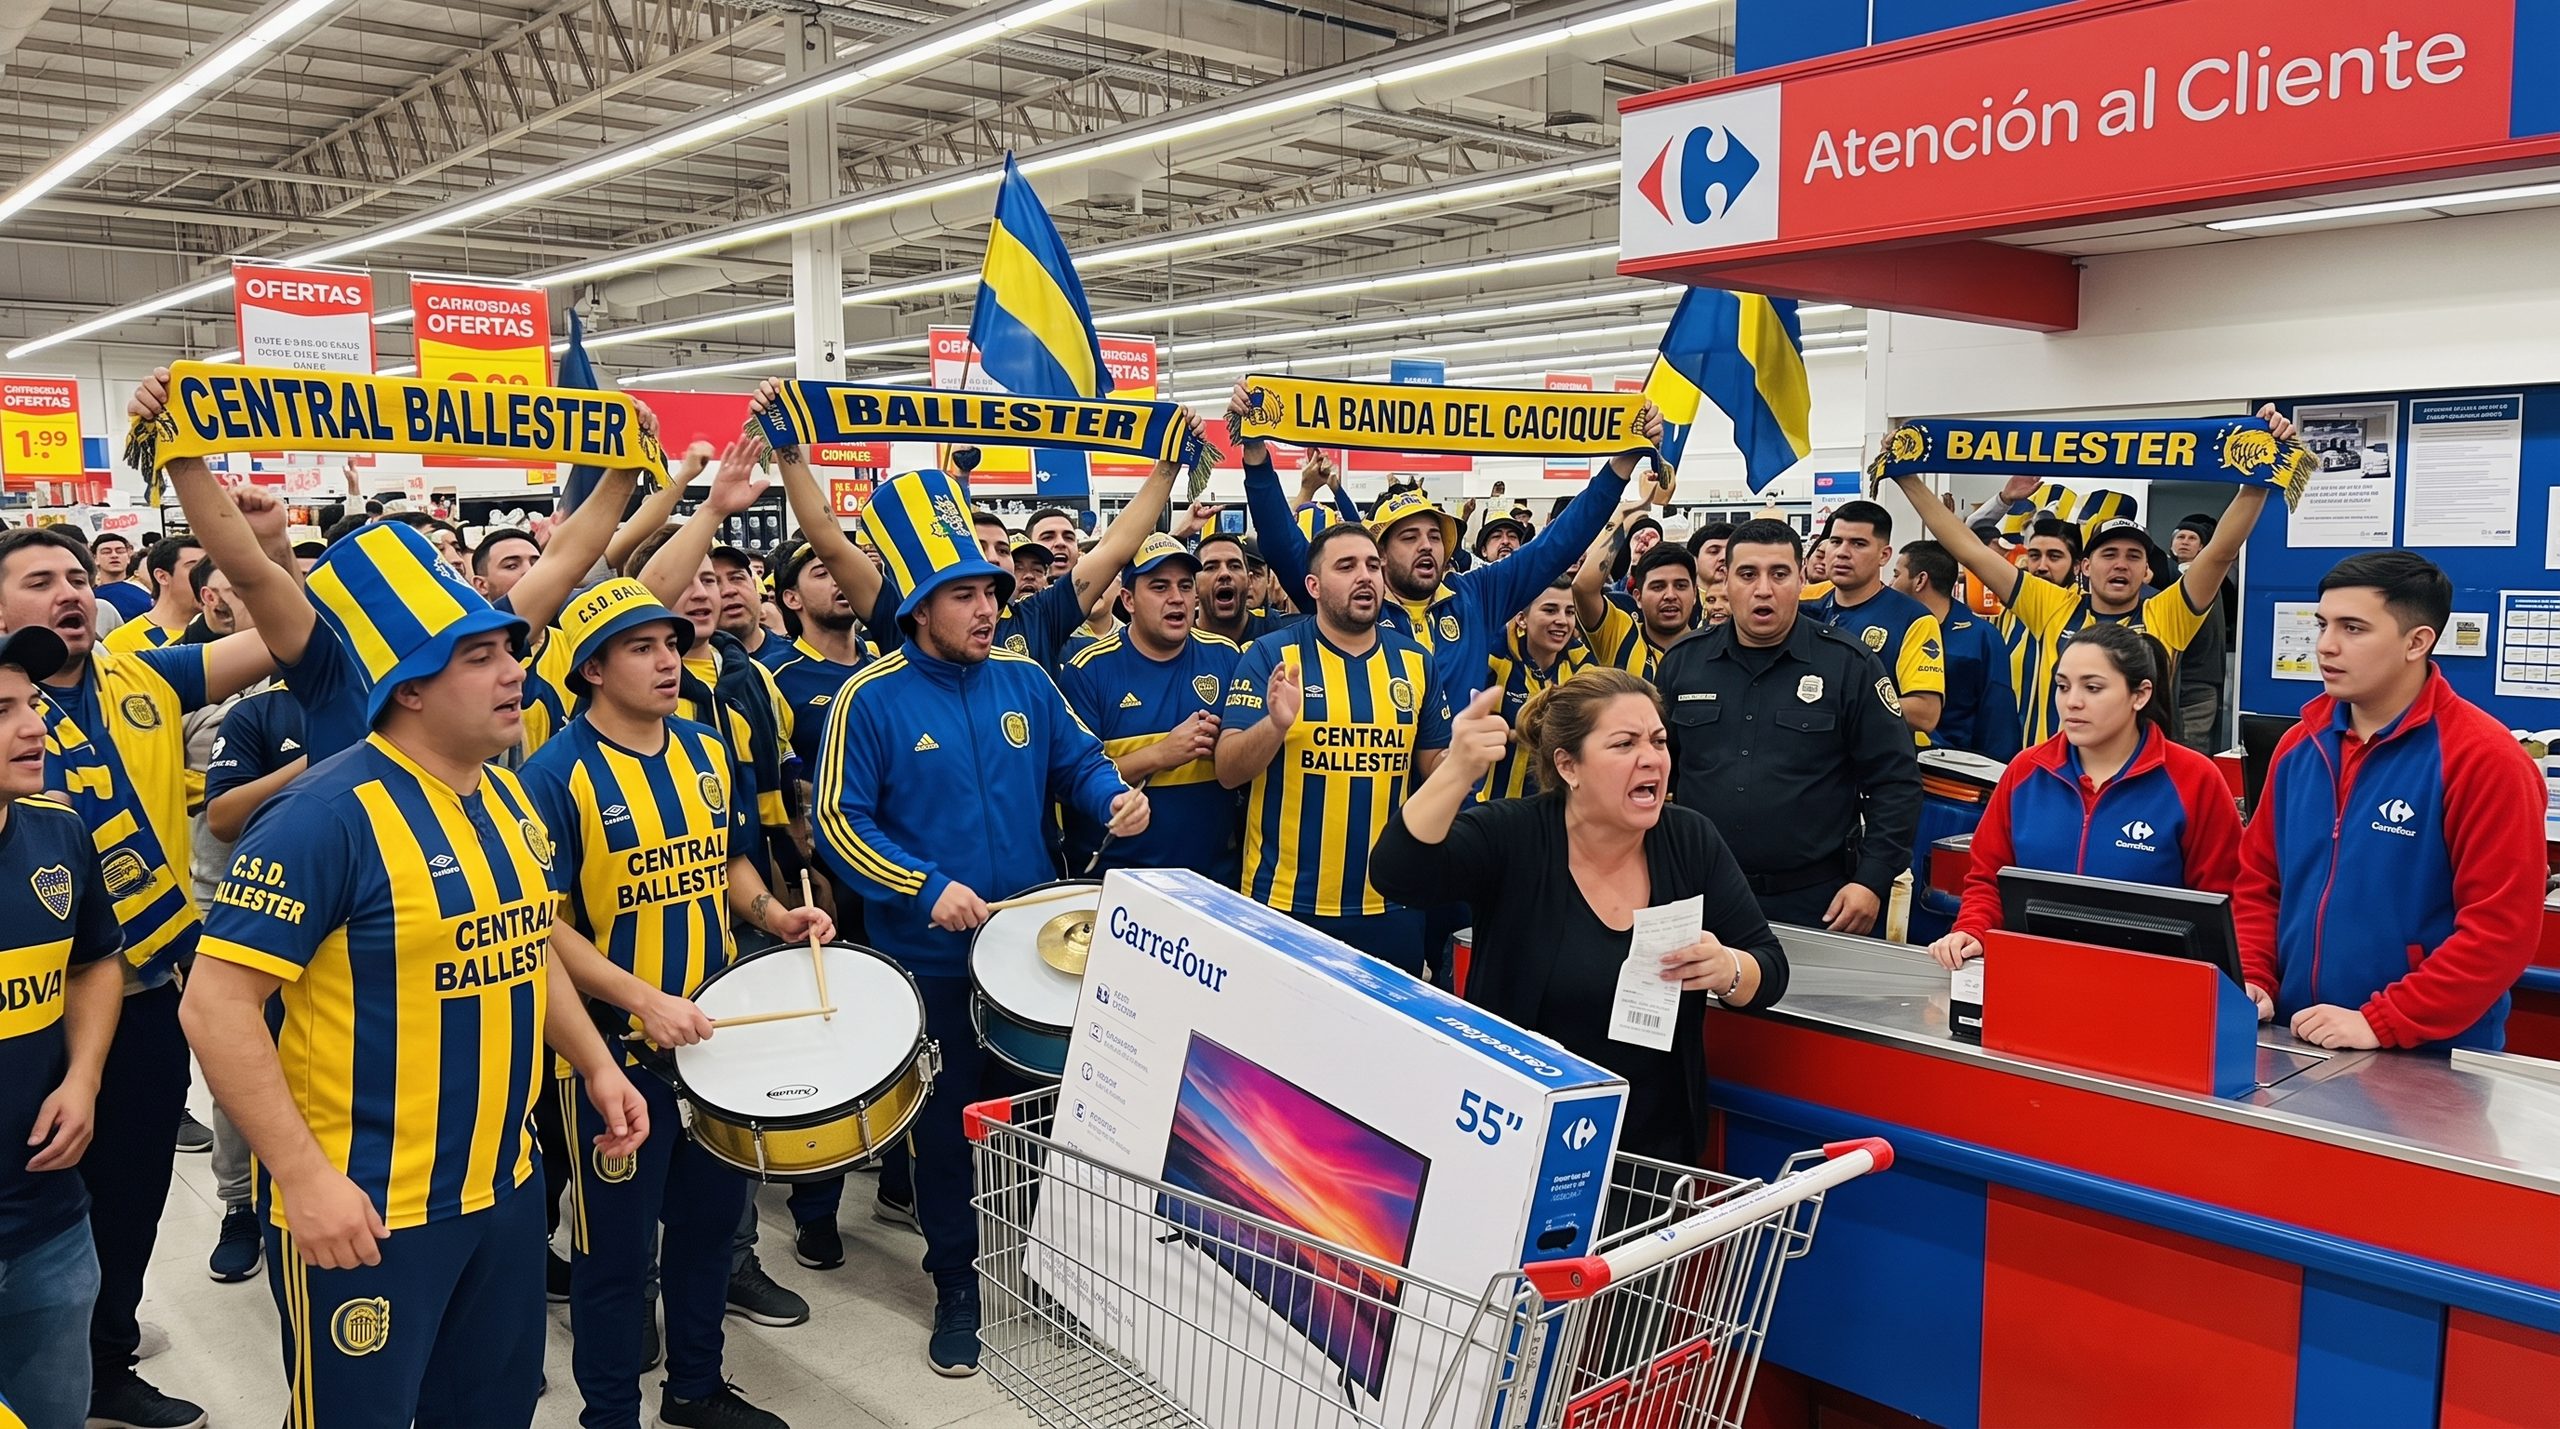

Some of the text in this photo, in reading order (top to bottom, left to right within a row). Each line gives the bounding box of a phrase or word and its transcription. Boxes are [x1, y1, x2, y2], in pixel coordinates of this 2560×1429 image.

[1804, 29, 2467, 184] Atención al Cliente
[245, 278, 362, 306] OFERTAS
[427, 313, 535, 338] OFERTAS
[4, 395, 72, 409] OFERTAS
[179, 376, 627, 458] CENTRAL BALLESTER
[842, 392, 1138, 441] BALLESTER
[1295, 392, 1625, 443] LA BANDA DEL CACIQUE
[1946, 429, 2198, 467] BALLESTER
[578, 585, 650, 624] C.S.D. BALL
[1313, 726, 1405, 748] CENTRAL
[231, 854, 286, 889] C.S.D.
[627, 834, 725, 877] CENTRAL
[455, 899, 554, 952] CENTRAL
[435, 936, 550, 992] BALLEST
[1109, 905, 1228, 994] Carrefour
[0, 968, 62, 1013] BVA
